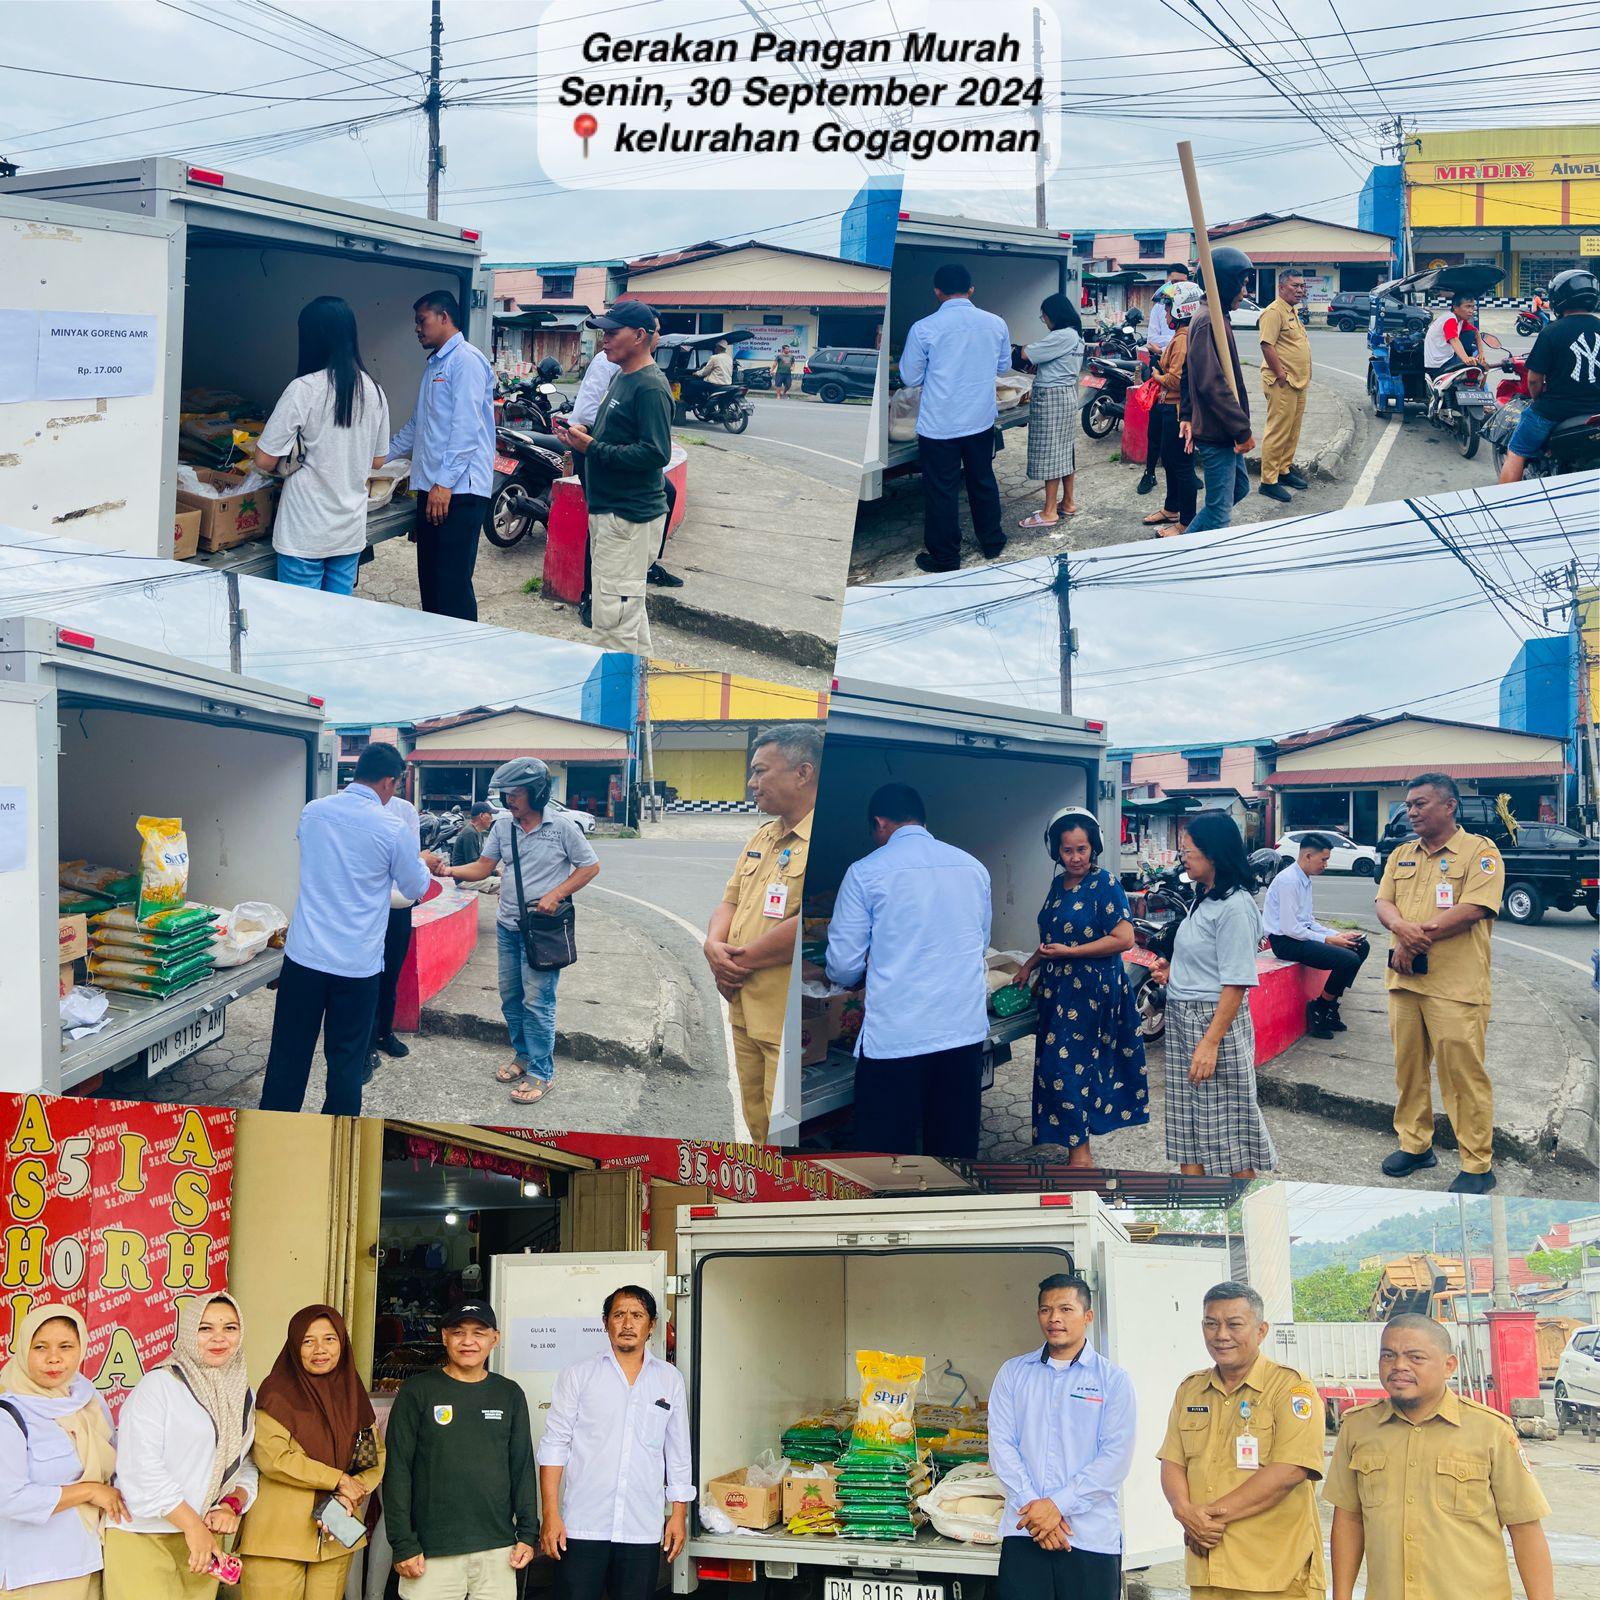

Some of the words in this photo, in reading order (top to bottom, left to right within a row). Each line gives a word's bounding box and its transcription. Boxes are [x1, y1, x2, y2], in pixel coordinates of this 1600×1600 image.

[1435, 165, 1477, 181] MR
[1481, 162, 1535, 180] D.I.Y.
[51, 328, 89, 337] MINYAK
[90, 329, 127, 338] GORENG
[129, 330, 148, 338] AMR
[77, 366, 92, 375] Rp.
[94, 365, 123, 374] 17.000
[151, 1037, 168, 1064] DM
[174, 1020, 202, 1050] 8116
[207, 1010, 221, 1033] AM
[208, 1112, 230, 1126] VIRAL
[624, 1154, 650, 1166] FASHION
[678, 1144, 757, 1198] 35.000
[100, 1292, 131, 1313] 35.000
[144, 1289, 169, 1308] VIRAL
[830, 1581, 852, 1600] DM
[862, 1583, 903, 1600] 8116
